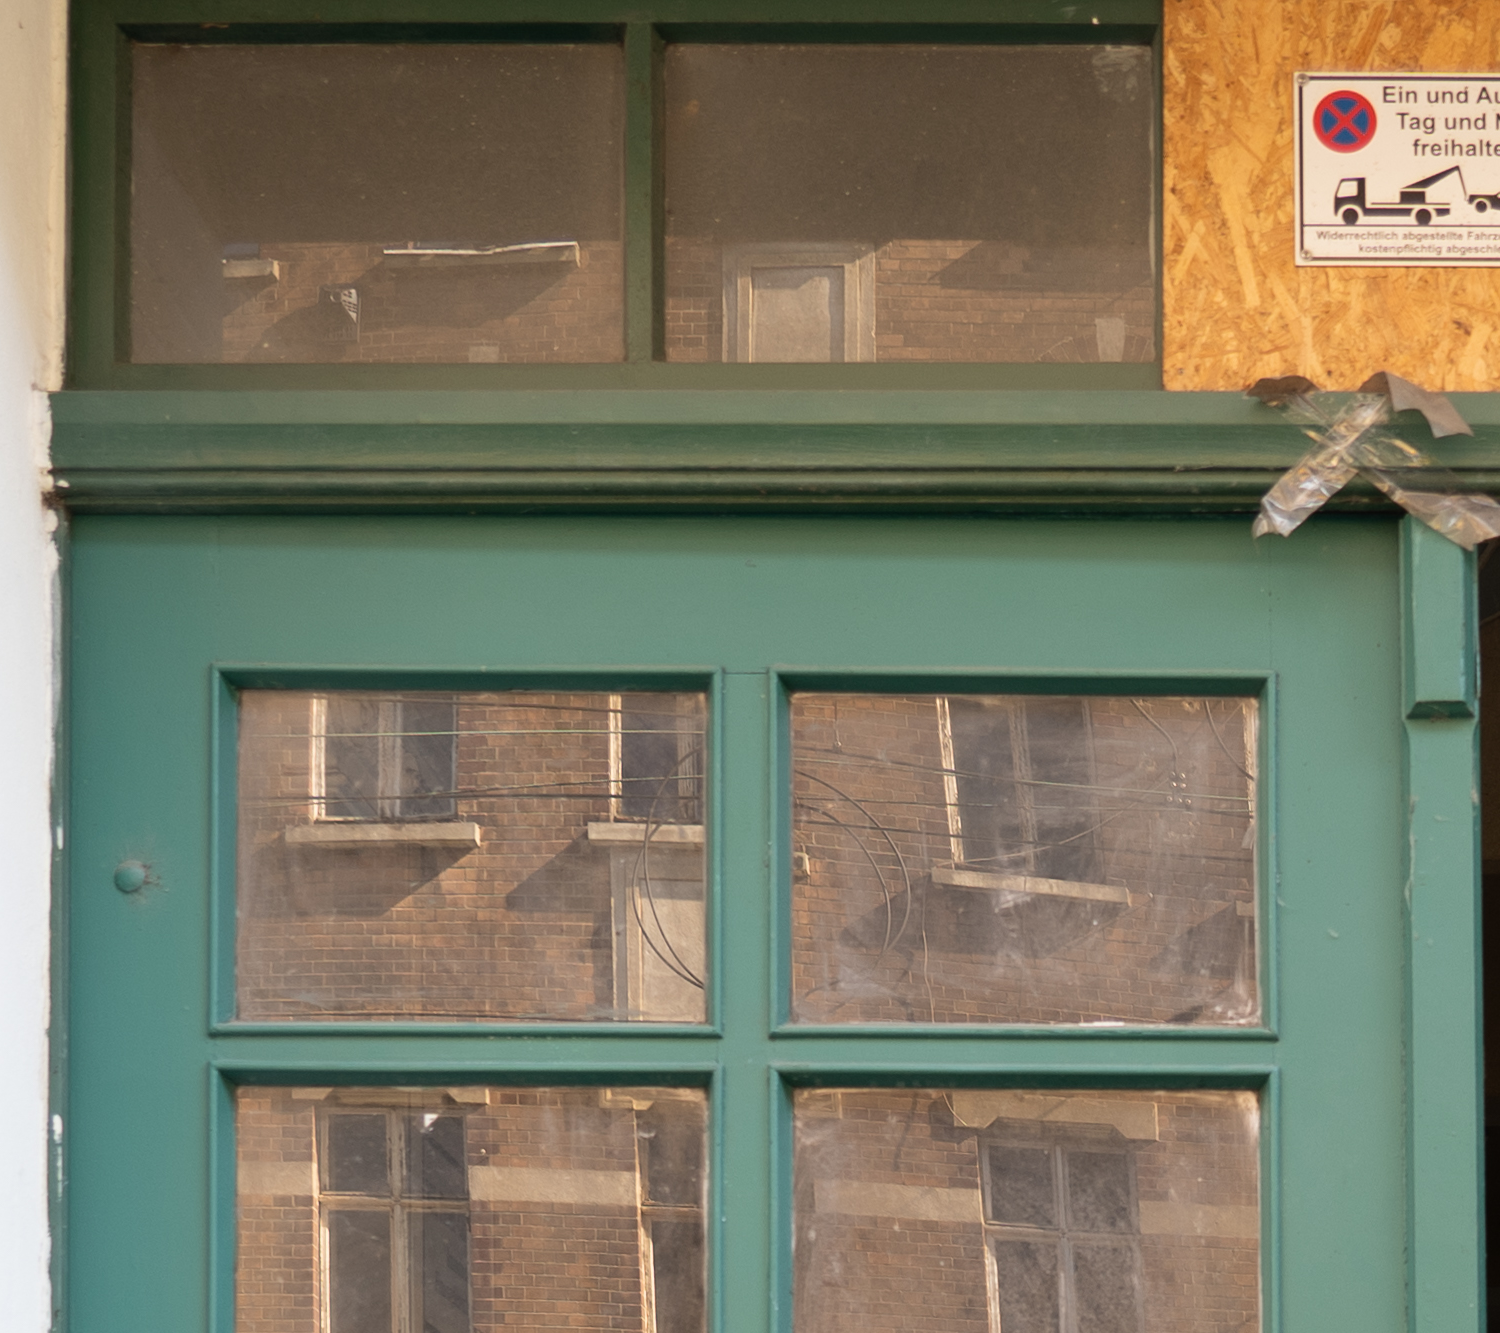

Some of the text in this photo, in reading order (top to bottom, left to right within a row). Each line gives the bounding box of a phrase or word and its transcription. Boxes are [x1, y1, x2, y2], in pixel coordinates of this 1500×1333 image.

[1382, 86, 1418, 104] Ein
[1426, 86, 1469, 104] und
[1396, 112, 1436, 134] Tag
[1444, 113, 1486, 131] und
[1316, 231, 1398, 241] Widerrechtlich
[1402, 231, 1463, 243] abgestellte
[1358, 243, 1442, 255] kostenpflichtig
